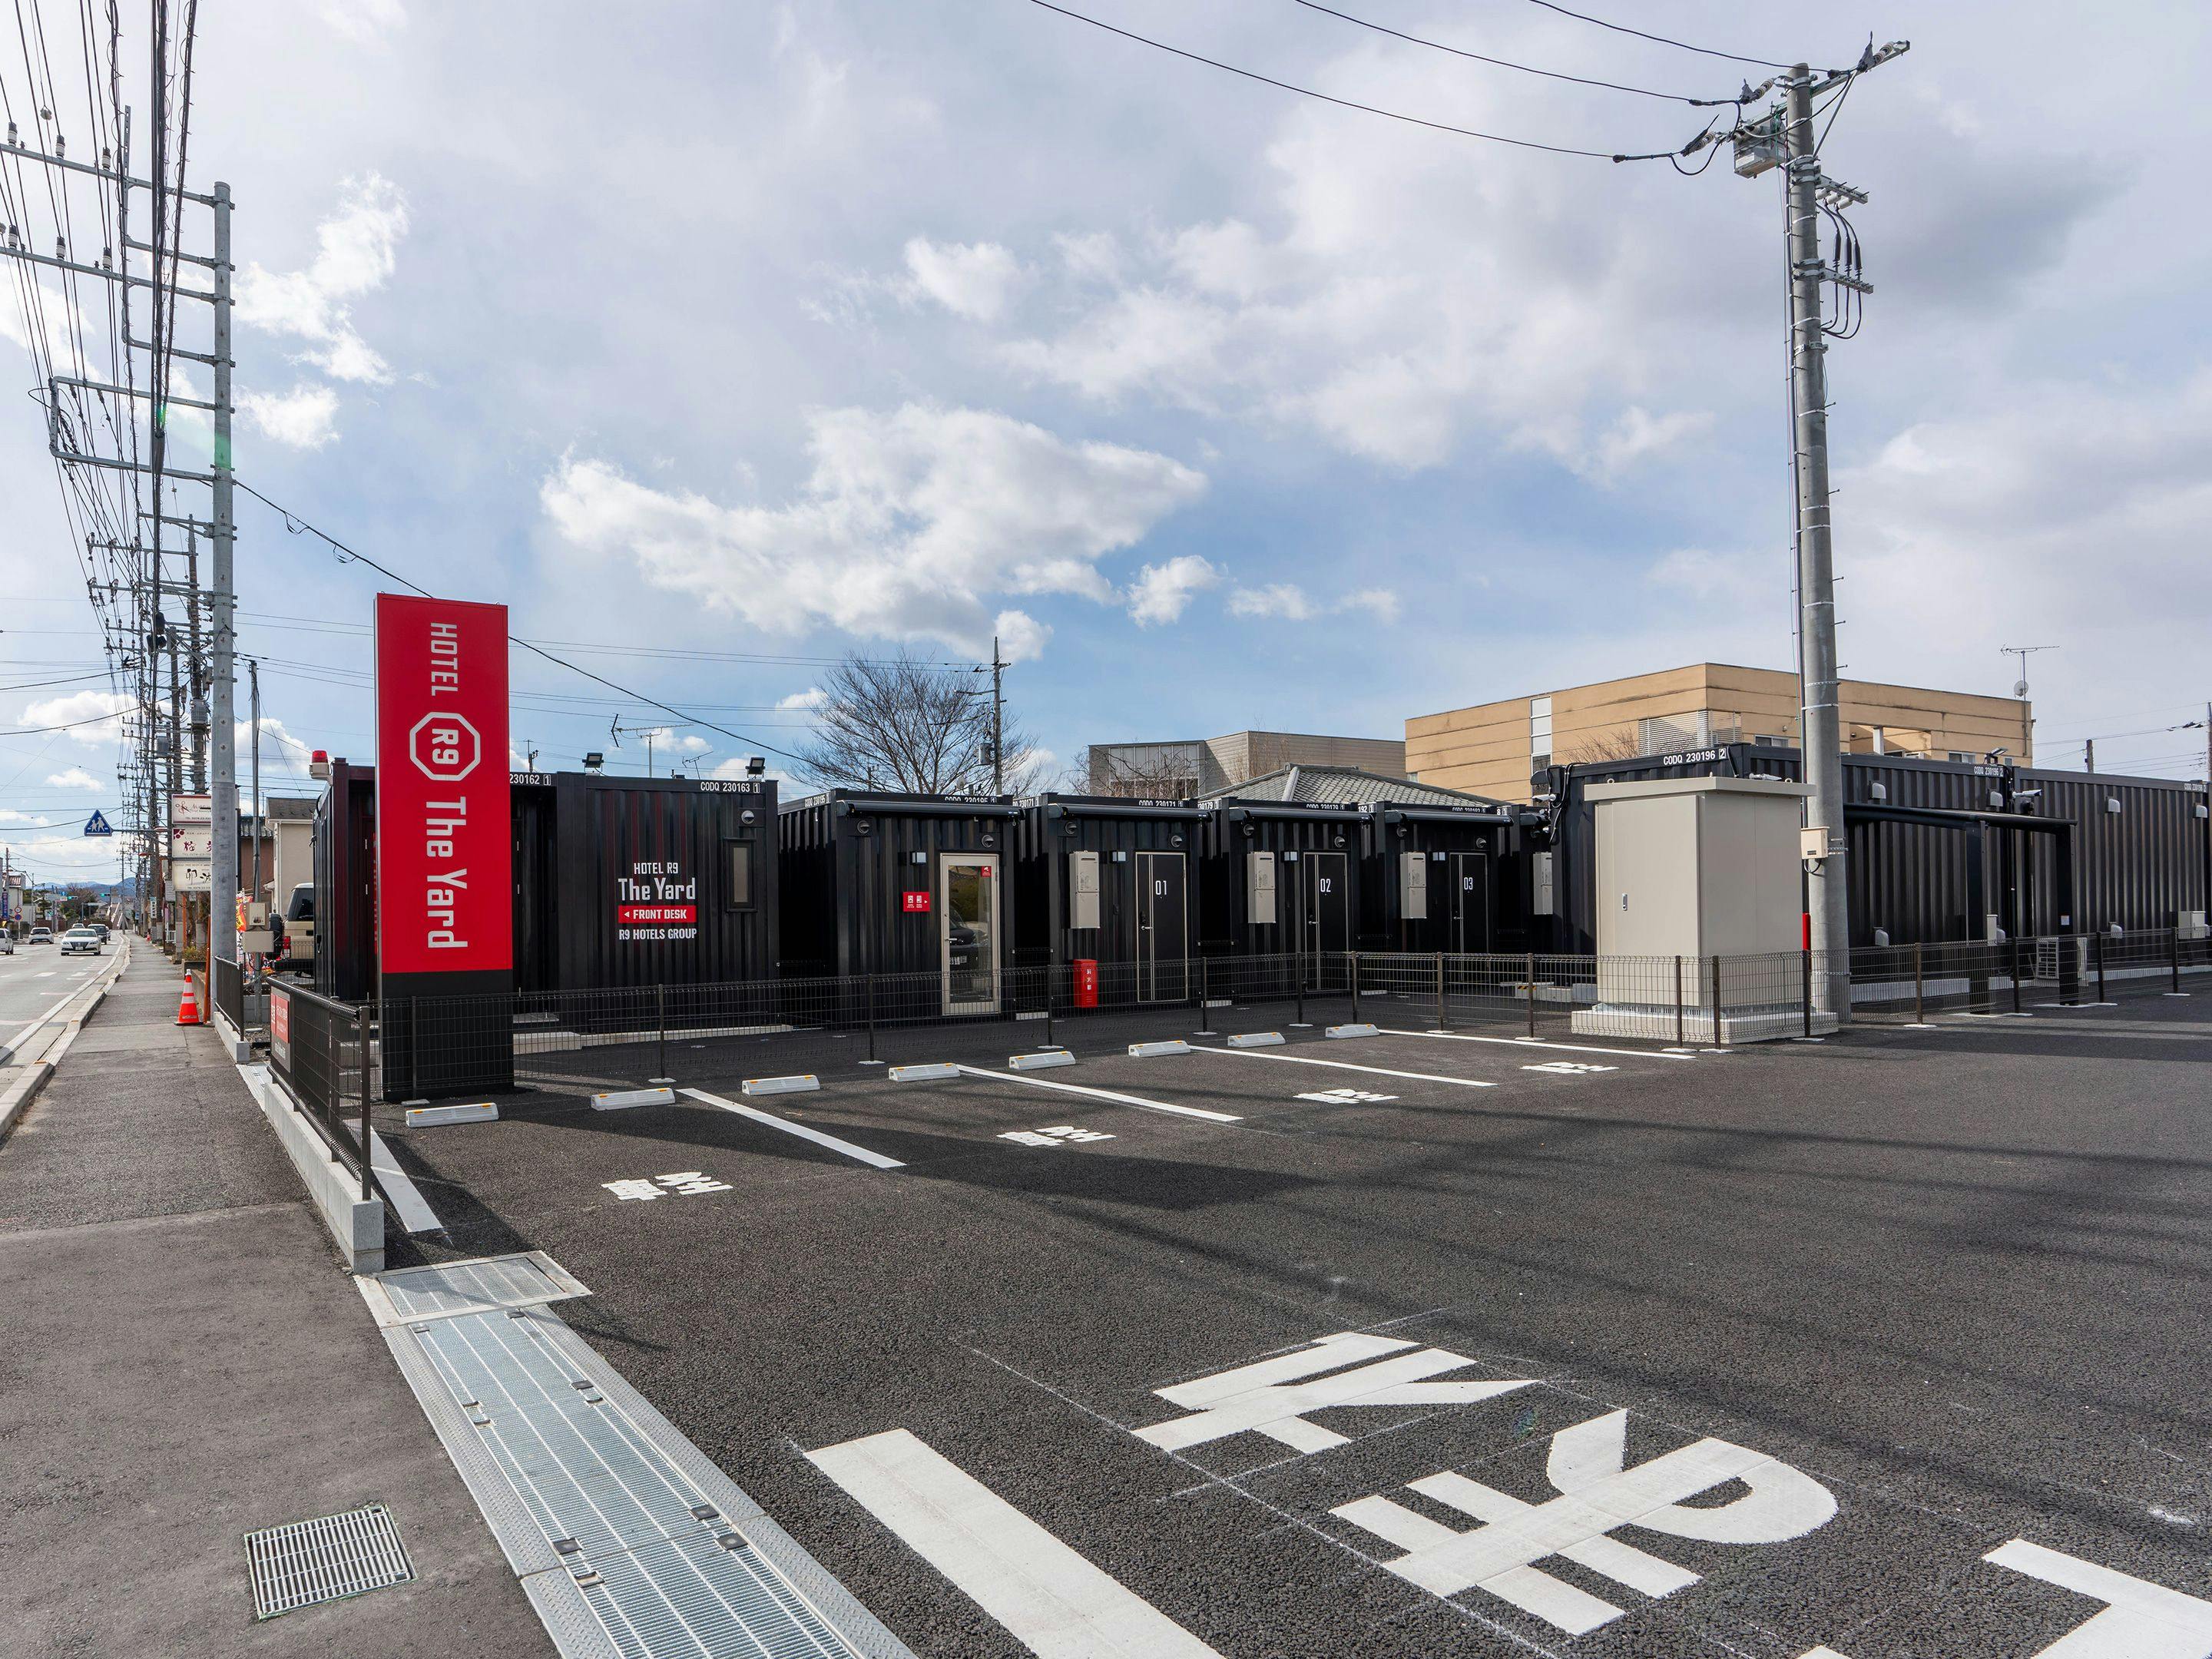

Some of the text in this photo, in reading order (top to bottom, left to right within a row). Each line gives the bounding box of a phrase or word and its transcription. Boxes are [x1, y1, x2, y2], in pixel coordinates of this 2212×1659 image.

[1664, 748, 1726, 765] CODQ 230196 2
[510, 773, 540, 784] 230162
[426, 623, 469, 949] HOTEL R9 The Yard
[700, 781, 720, 791] CODQ
[723, 783, 750, 792] 230163
[634, 862, 678, 874] HOTEL R9
[618, 877, 695, 901] The Yard
[1155, 880, 1167, 896] 01
[1320, 878, 1331, 892] 02
[1463, 876, 1473, 890] 03
[633, 909, 687, 919] FRONT DESK
[619, 928, 697, 940] R9 HOTELS GROUP
